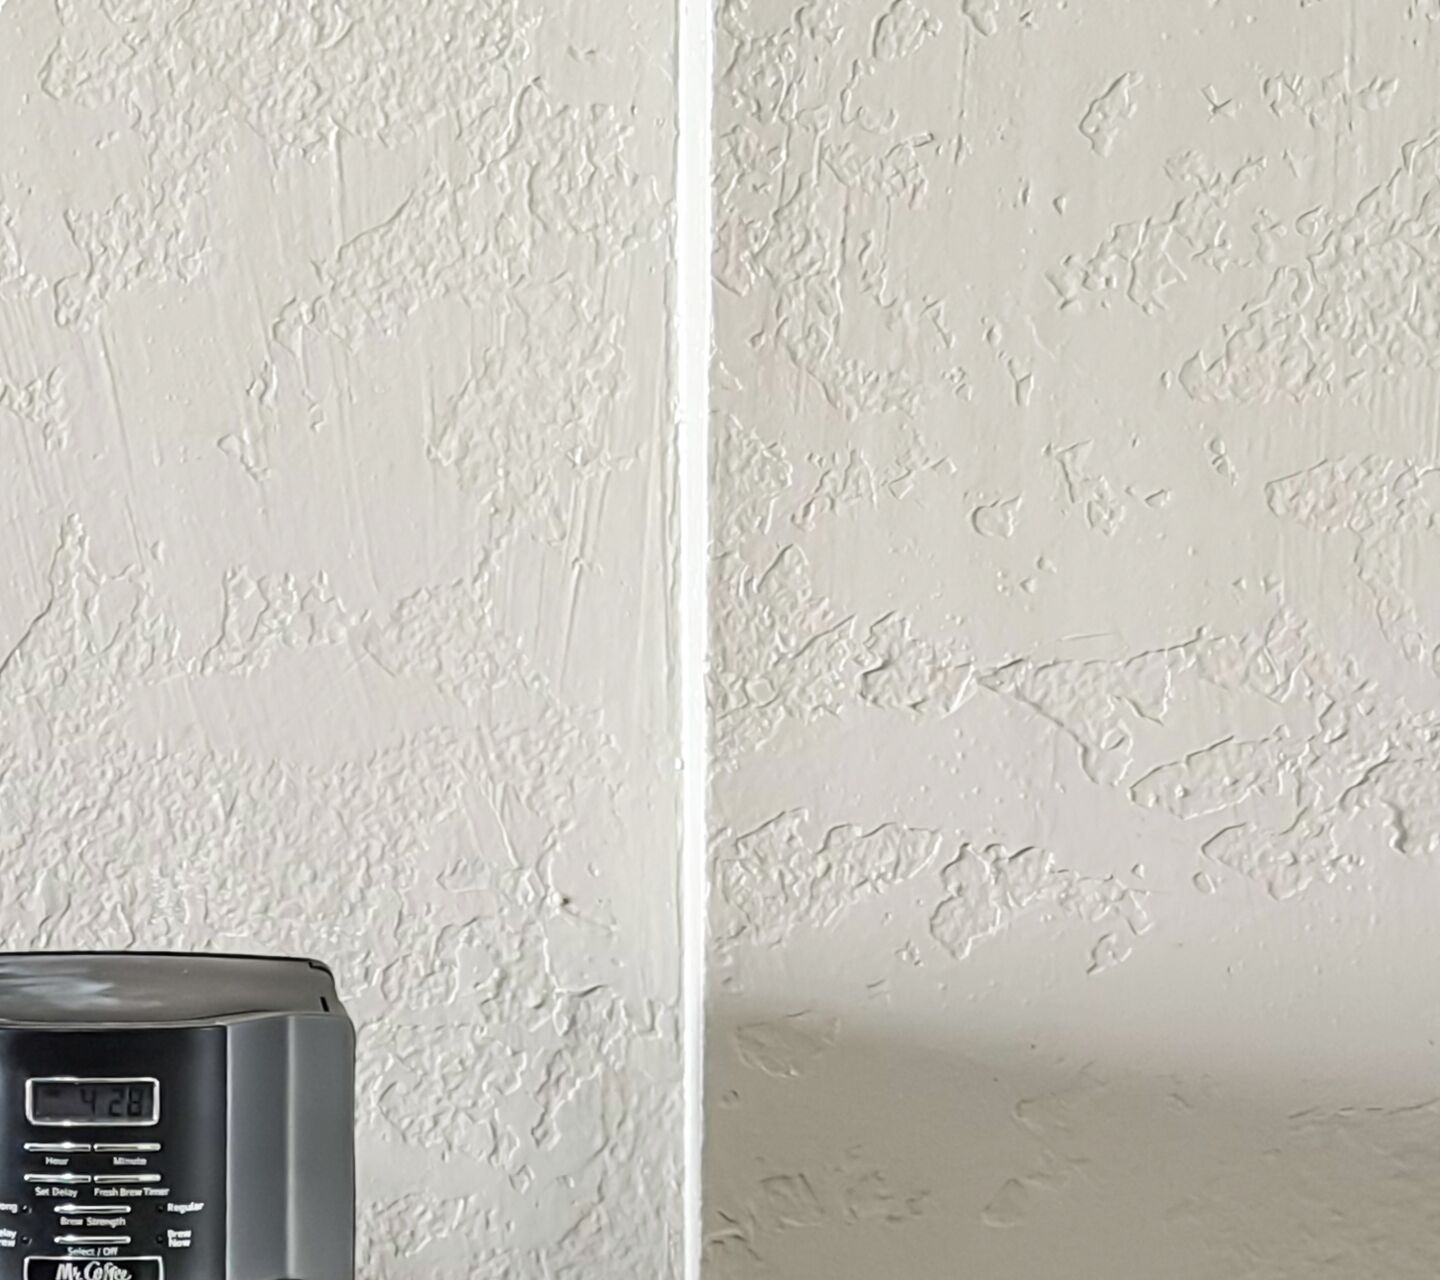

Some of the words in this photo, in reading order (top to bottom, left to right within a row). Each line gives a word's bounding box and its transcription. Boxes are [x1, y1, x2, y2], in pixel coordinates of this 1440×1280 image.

[45, 1156, 69, 1165] Hour
[113, 1156, 147, 1165] Minute
[34, 1186, 50, 1196] Set
[51, 1187, 78, 1198] Delay
[94, 1187, 119, 1196] Fresh
[120, 1187, 142, 1196] Brew
[143, 1187, 170, 1196] Timer
[167, 1202, 204, 1214] Regular
[60, 1216, 84, 1226] Brew
[86, 1216, 126, 1228] Strength
[167, 1229, 192, 1238] Brew
[168, 1238, 191, 1247] Now
[67, 1246, 95, 1256] Select
[102, 1246, 119, 1256] Off
